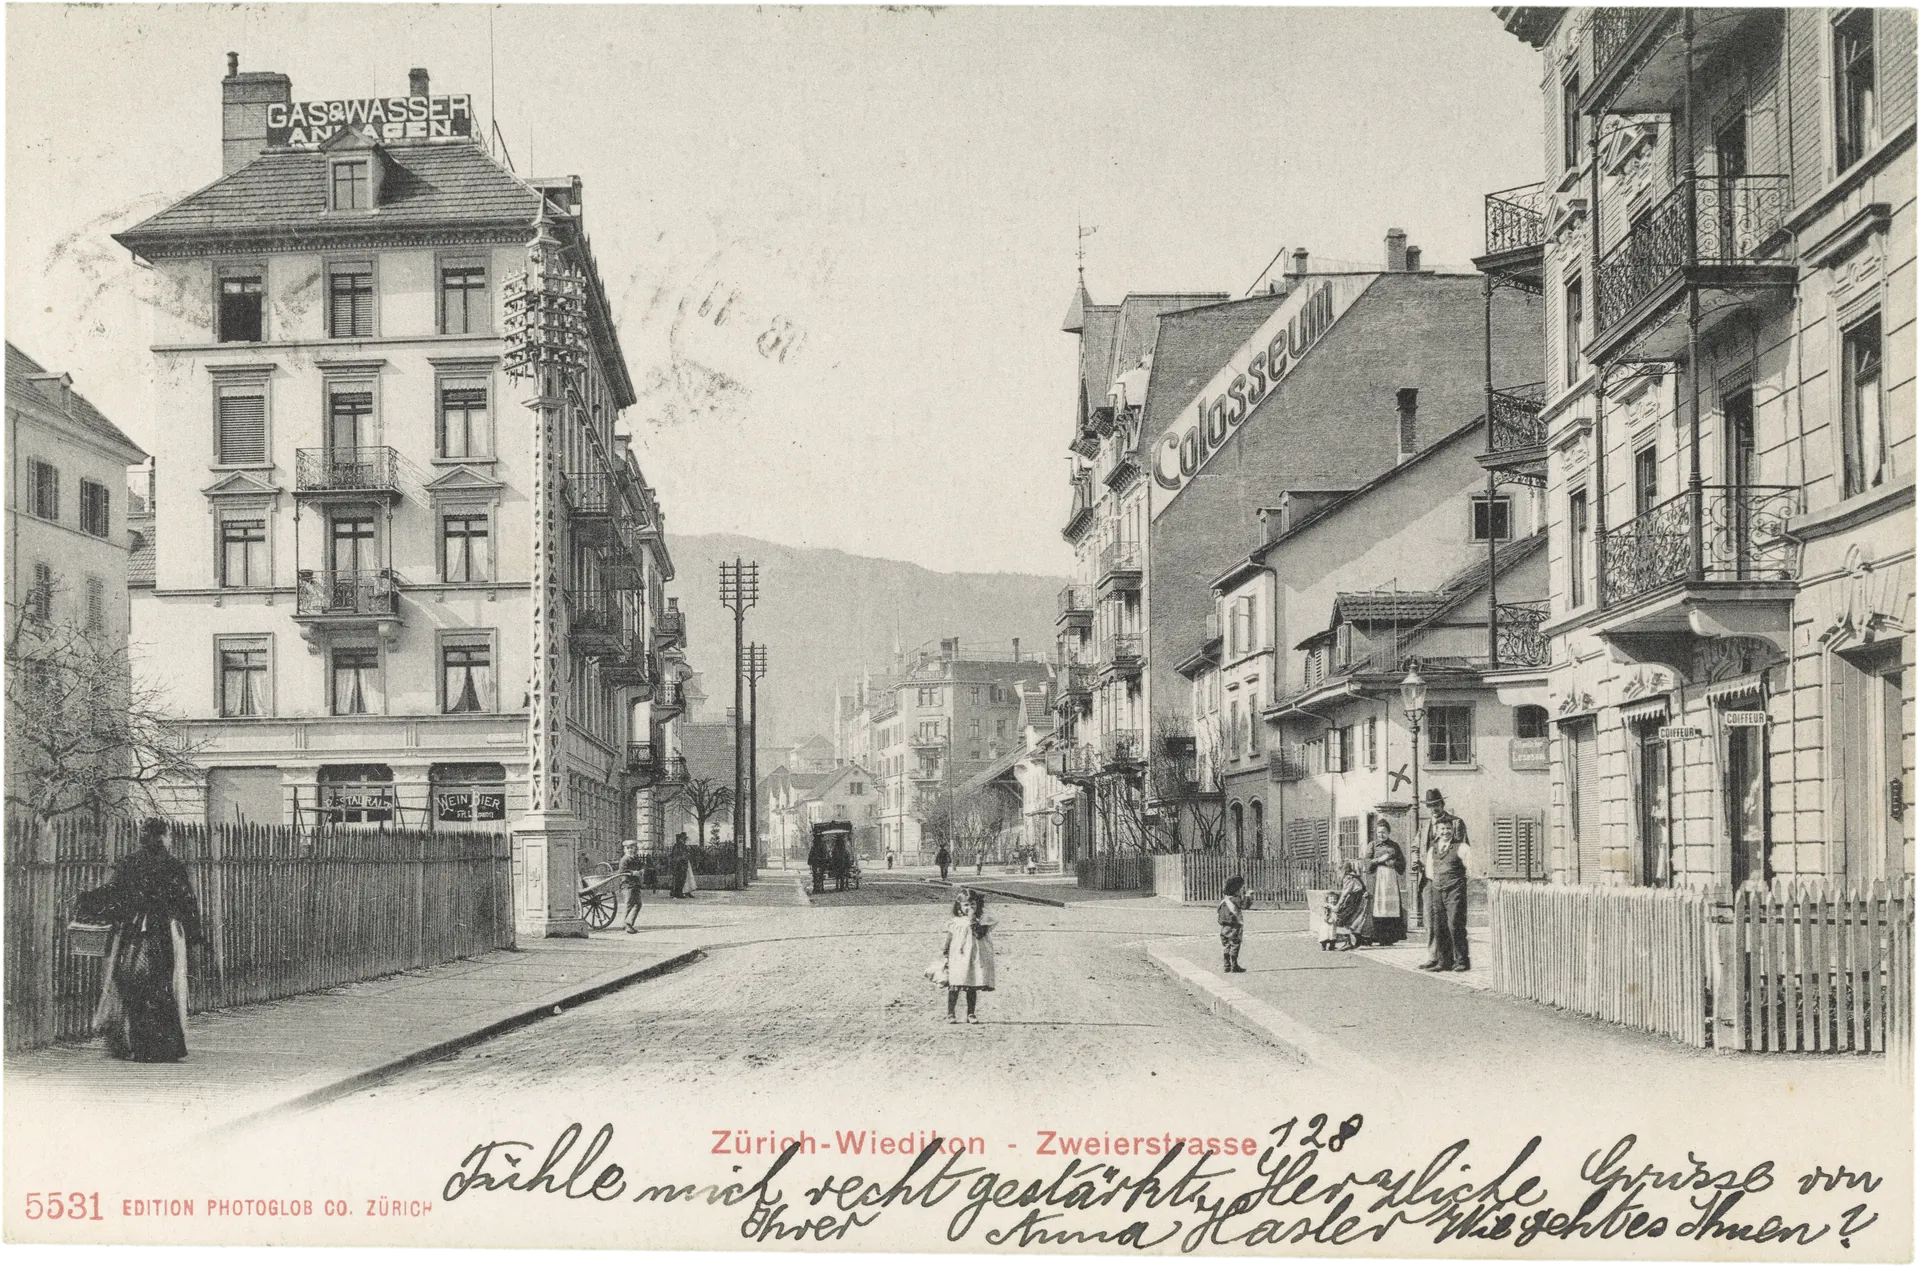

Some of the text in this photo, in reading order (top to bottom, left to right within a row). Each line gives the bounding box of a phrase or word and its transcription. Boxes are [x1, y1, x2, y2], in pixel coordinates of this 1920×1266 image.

[288, 120, 458, 144] ANAGEN.
[1153, 280, 1335, 490] Colosseum
[1660, 727, 1695, 738] COIFFEUR
[1726, 712, 1765, 724] COIFFEUR
[434, 789, 500, 816] WEIN BIER
[1269, 1113, 1363, 1152] 128
[442, 1122, 627, 1201] Fühle
[632, 1141, 801, 1206] mich
[805, 1137, 986, 1209] recht
[741, 1202, 882, 1243] Ihrer
[986, 1208, 1182, 1248] Anna
